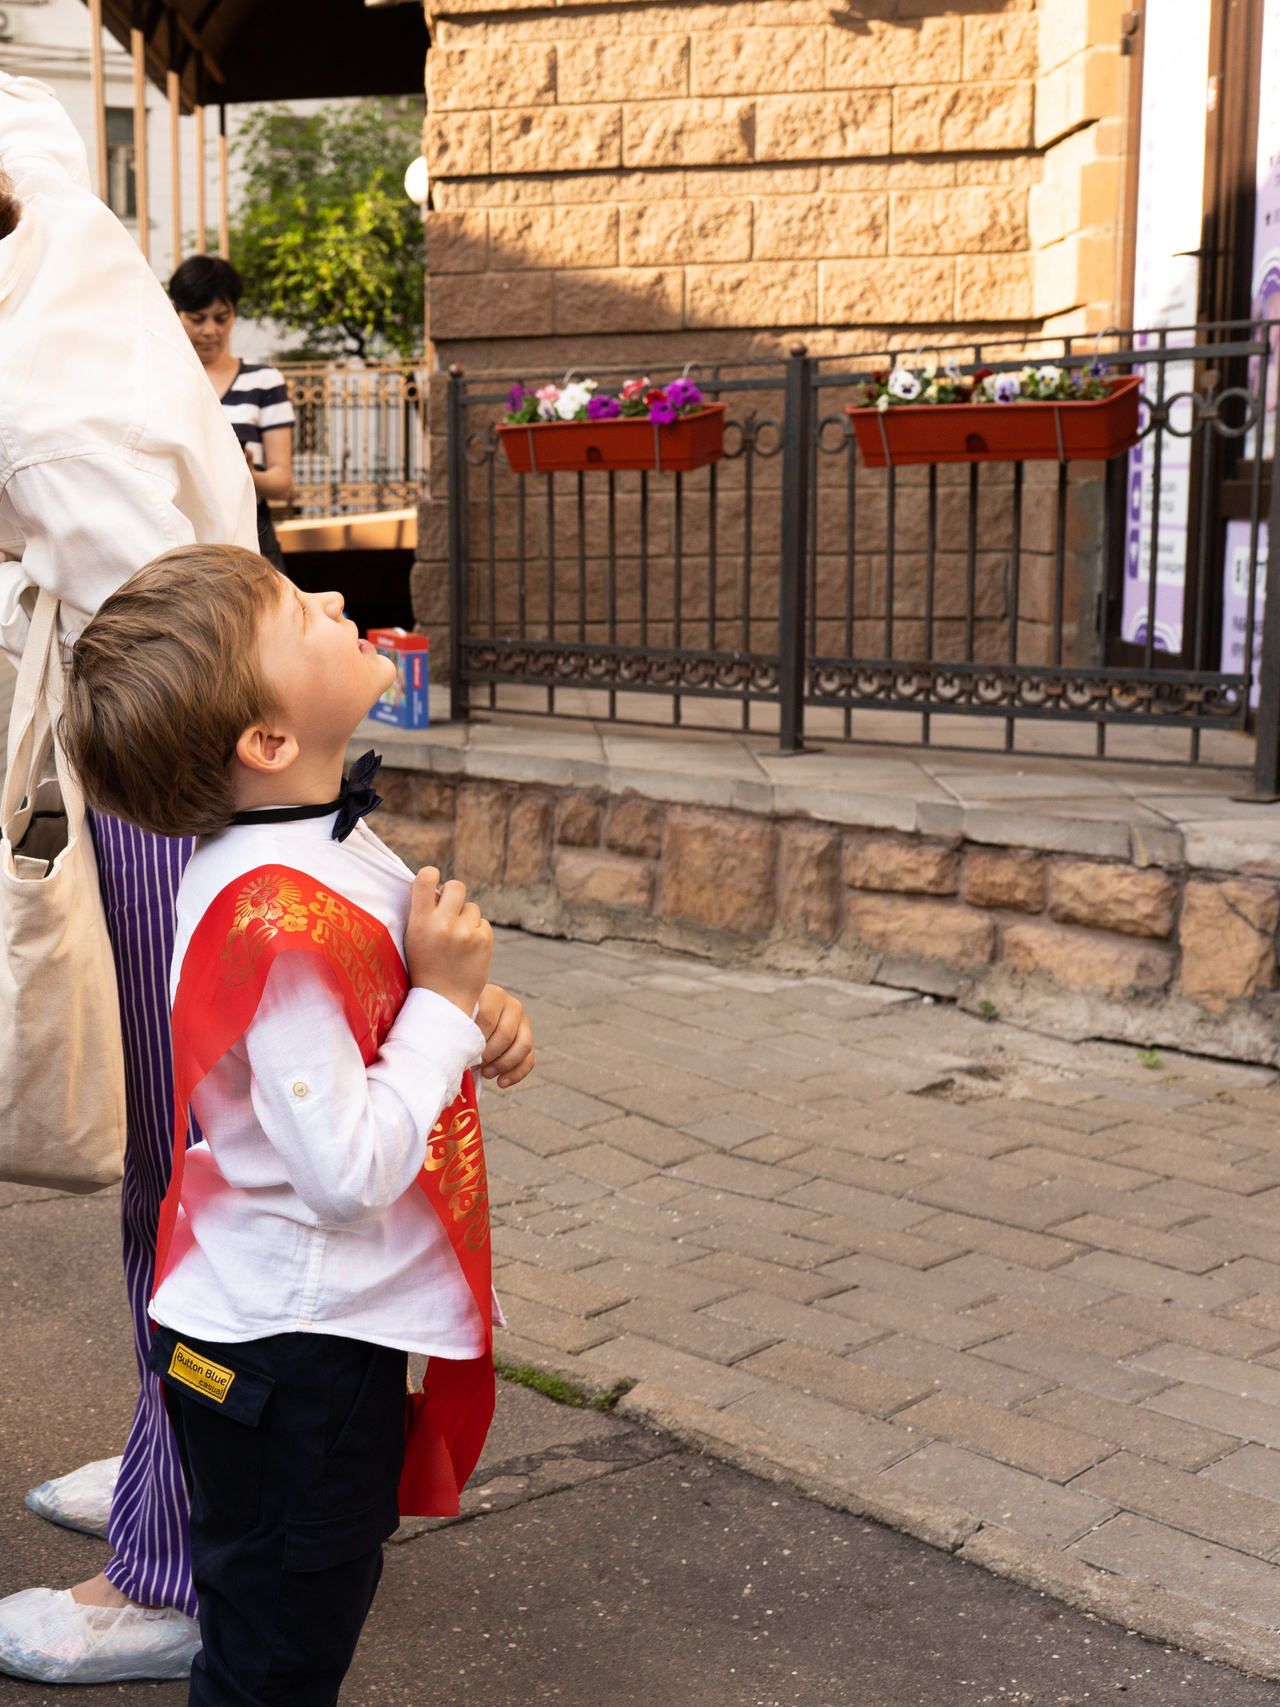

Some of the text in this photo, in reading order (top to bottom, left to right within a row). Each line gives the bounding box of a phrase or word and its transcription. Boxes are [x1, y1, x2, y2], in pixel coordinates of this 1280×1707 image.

[176, 1351, 227, 1386] Button Blue
[198, 1379, 224, 1397] casual
